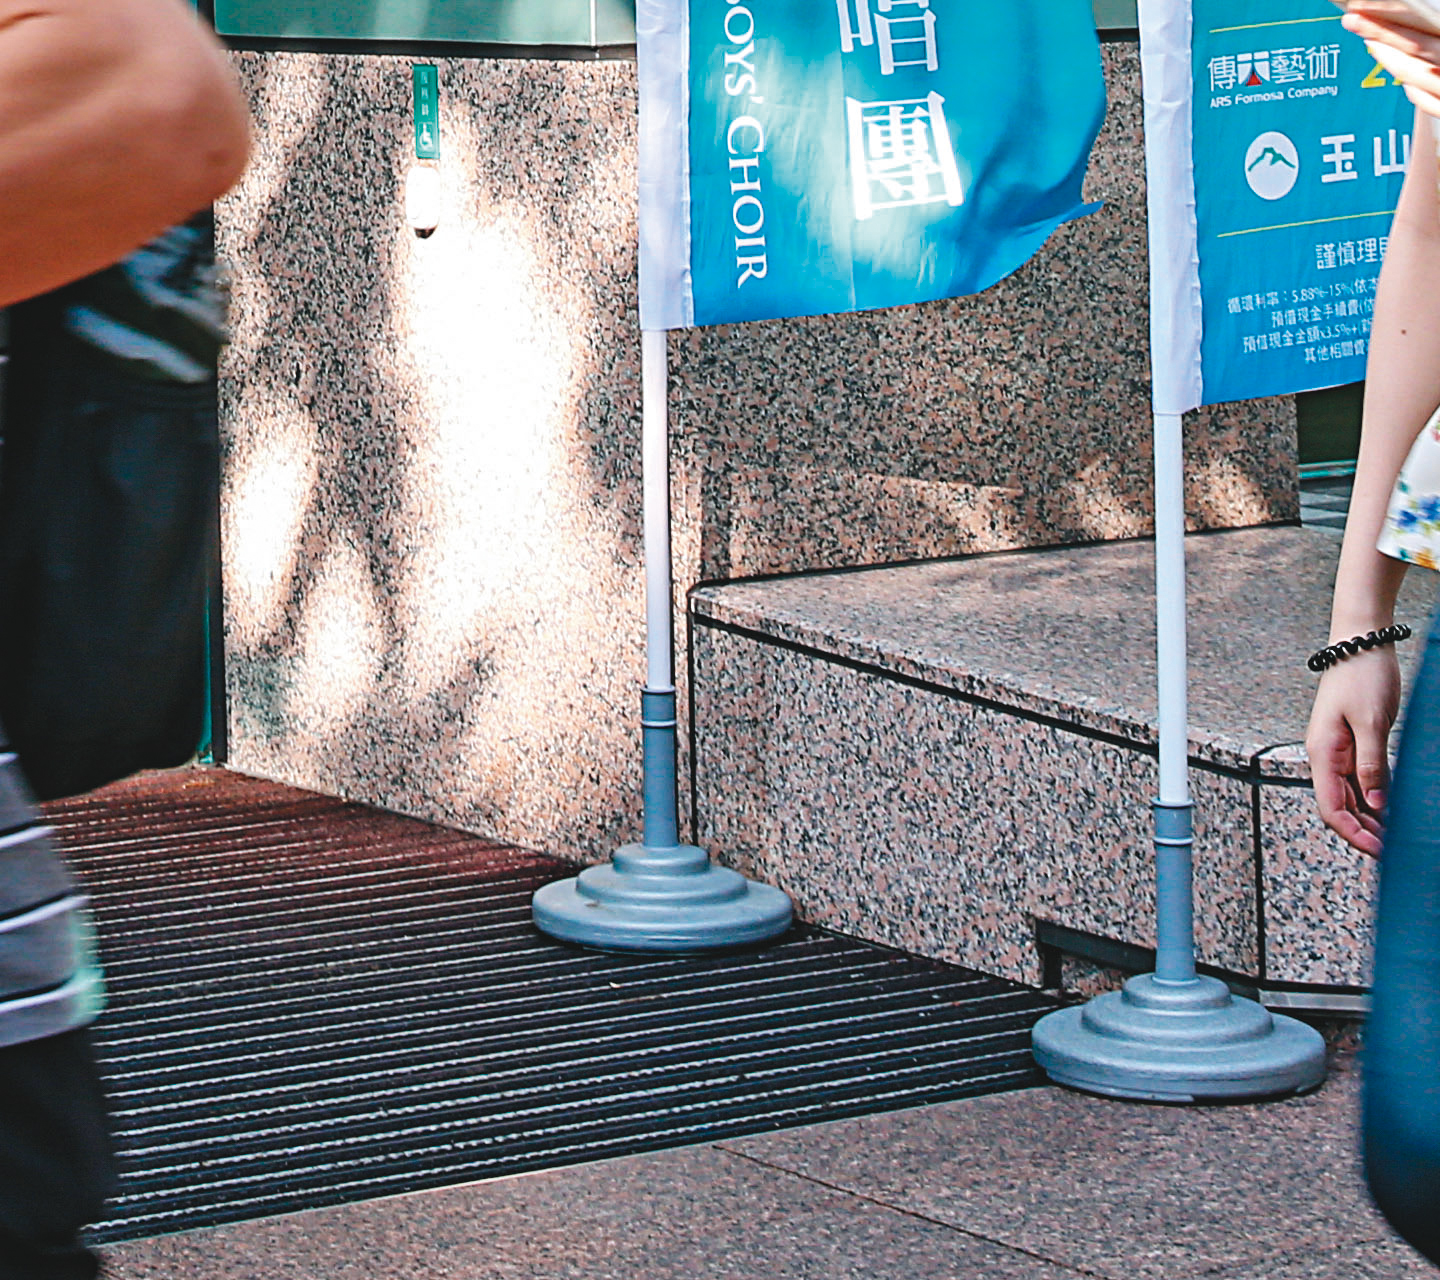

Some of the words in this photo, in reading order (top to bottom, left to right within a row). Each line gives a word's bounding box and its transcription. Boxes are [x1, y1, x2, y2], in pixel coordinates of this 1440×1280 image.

[1210, 95, 1232, 109] ARS
[1235, 91, 1284, 105] Formosa
[1287, 85, 1338, 99] Company
[726, 117, 768, 289] CHOIR
